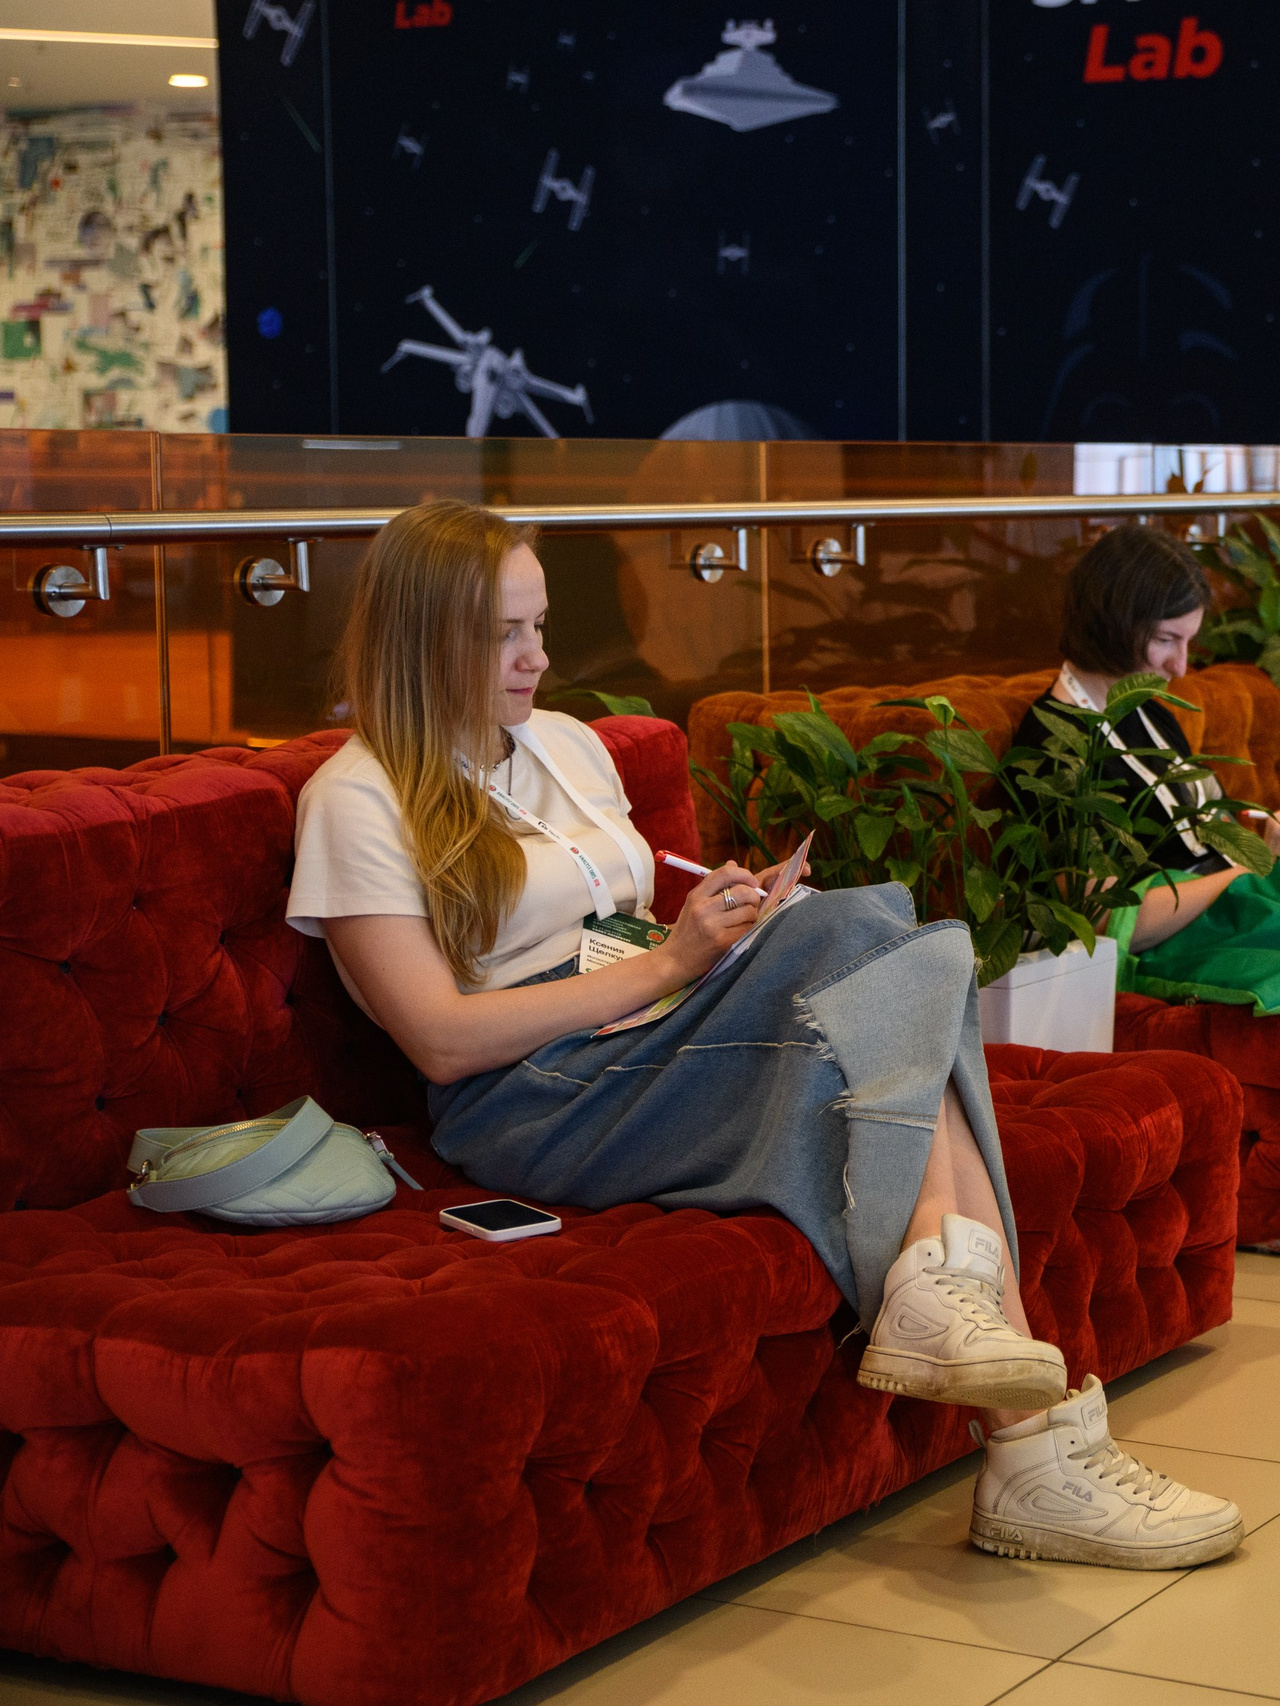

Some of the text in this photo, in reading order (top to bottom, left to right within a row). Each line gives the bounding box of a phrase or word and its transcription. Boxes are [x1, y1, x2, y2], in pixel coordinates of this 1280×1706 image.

[394, 0, 453, 29] Lab
[1083, 16, 1223, 83] Lab
[590, 938, 624, 954] Ксения
[975, 1237, 999, 1259] FILA
[1062, 1481, 1093, 1503] FILA
[990, 1525, 1024, 1542] FILA
